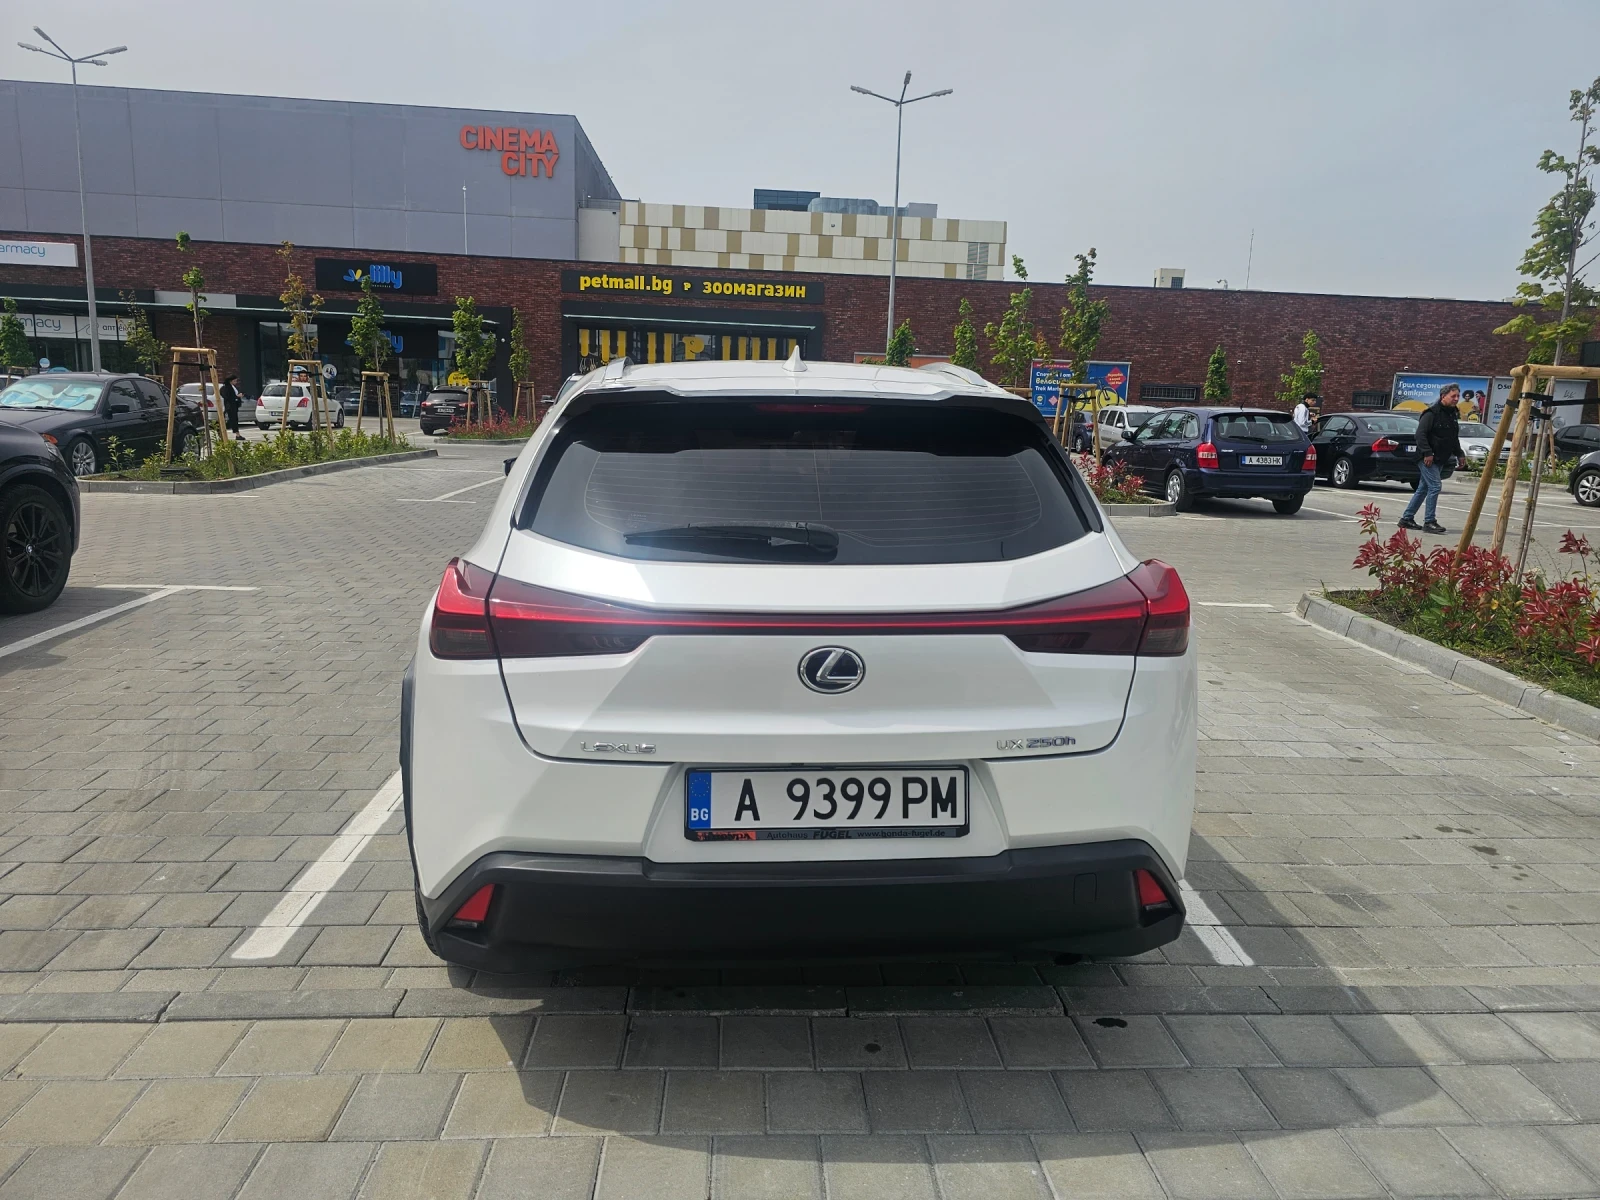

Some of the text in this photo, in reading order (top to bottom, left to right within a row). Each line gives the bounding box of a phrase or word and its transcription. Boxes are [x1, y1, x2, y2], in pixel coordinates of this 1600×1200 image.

[460, 125, 559, 154] CINEMA
[501, 152, 559, 178] CITY
[370, 264, 403, 289] lilly
[580, 274, 673, 295] petmall.bg
[702, 281, 806, 298] зоомагазин
[580, 741, 656, 754] LEXUS
[996, 736, 1076, 750] UX 250h
[690, 808, 709, 821] BG
[734, 778, 761, 821] A
[766, 831, 809, 841] Autohaus
[856, 829, 947, 839] www.honda-fugel.de
